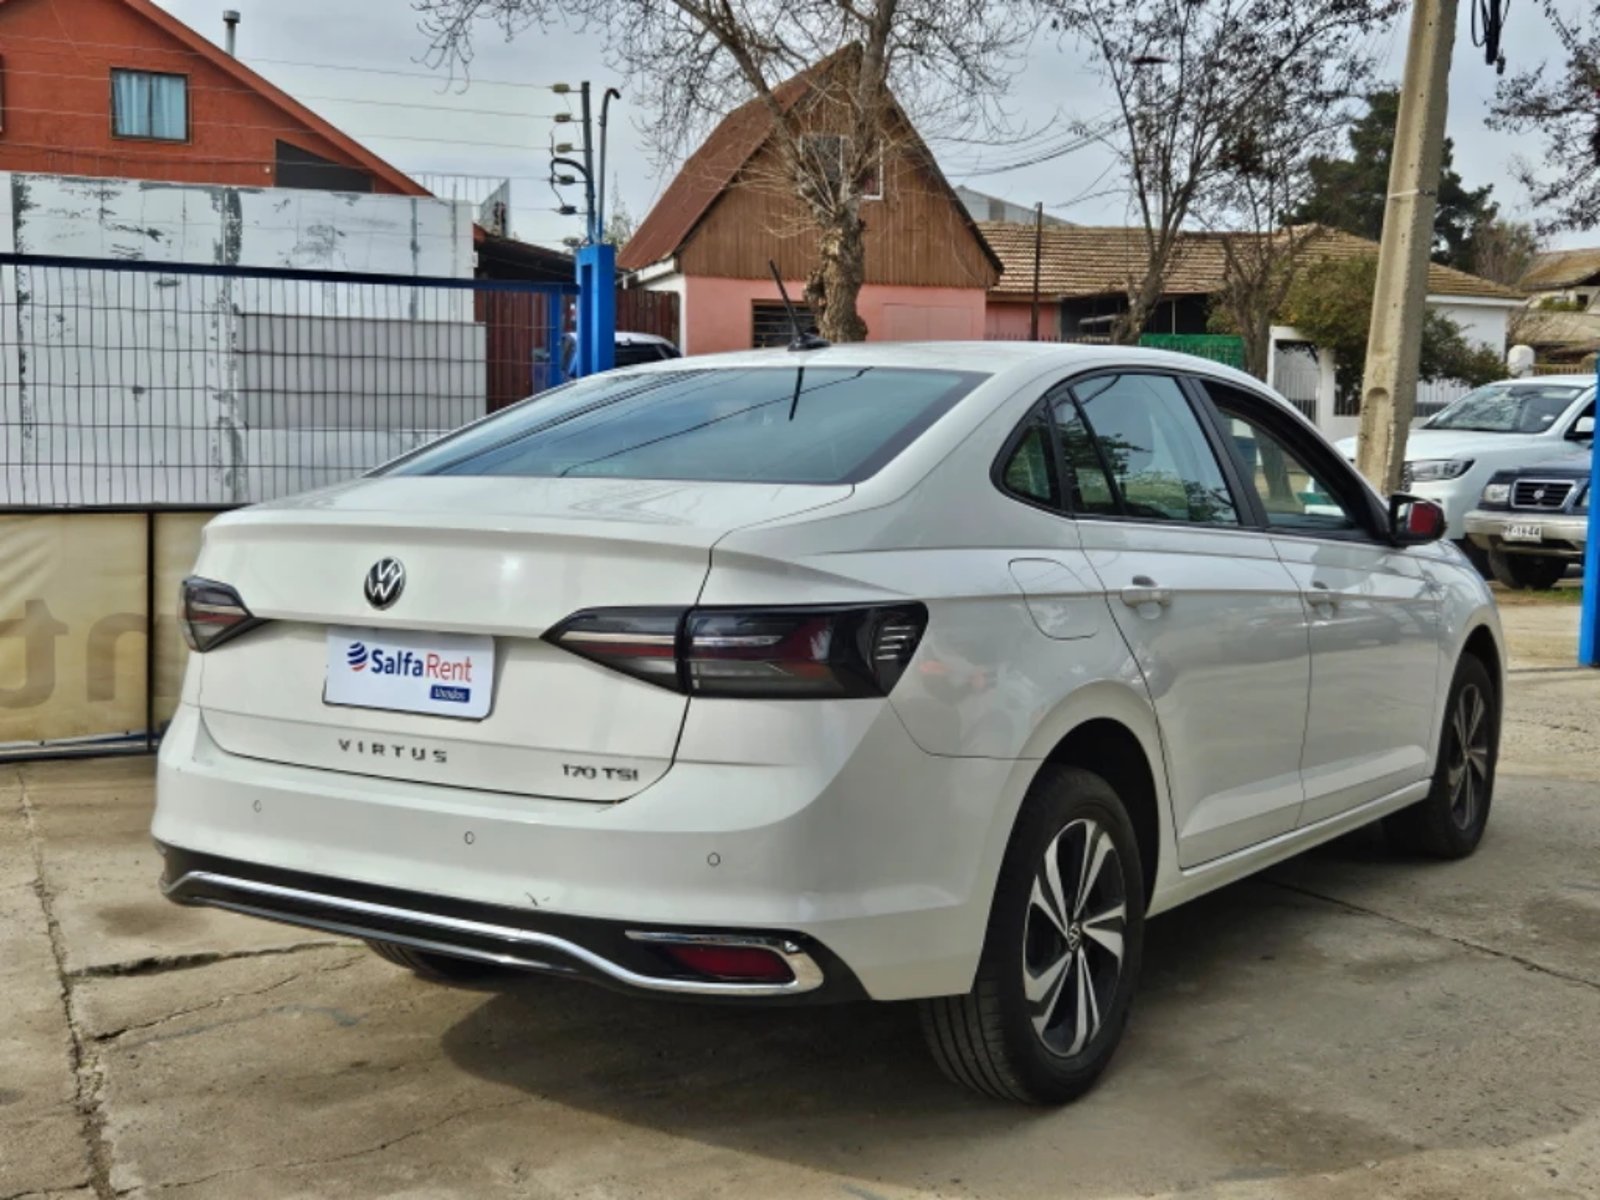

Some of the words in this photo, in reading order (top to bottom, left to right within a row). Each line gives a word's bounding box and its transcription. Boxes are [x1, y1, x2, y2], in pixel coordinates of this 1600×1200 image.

[370, 648, 473, 682] SalfaRent
[338, 739, 447, 763] VIRTUS
[562, 764, 597, 780] 170
[601, 767, 638, 781] TSI
